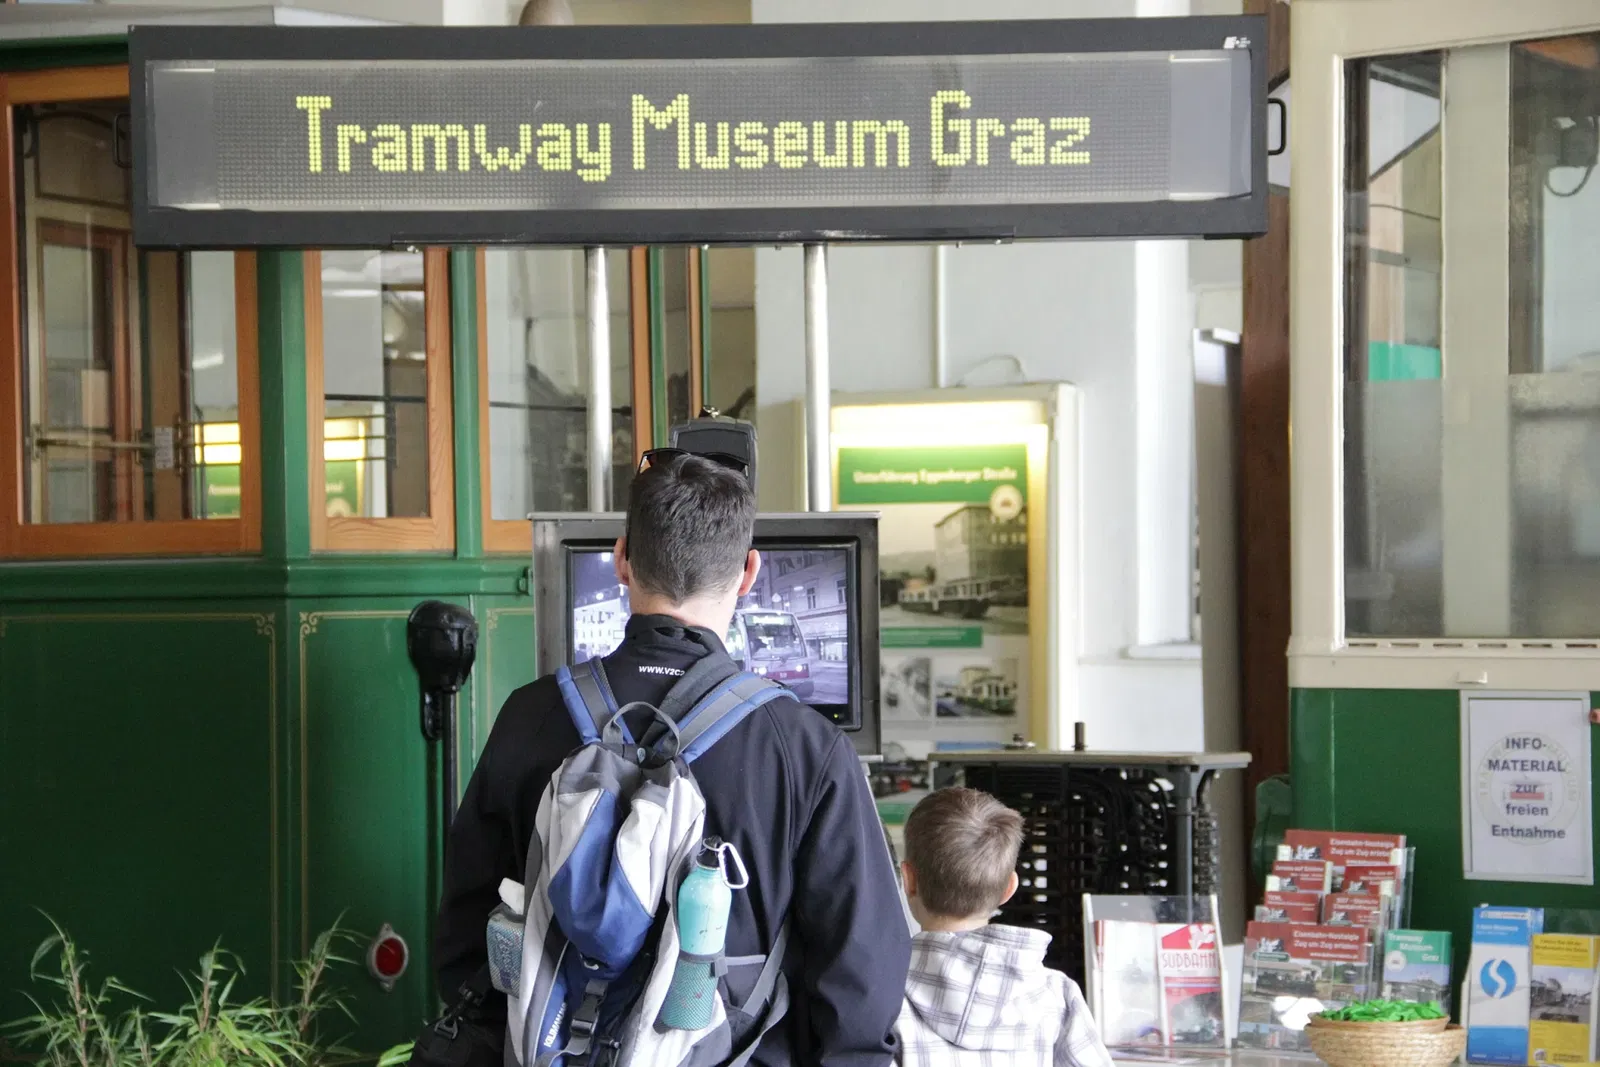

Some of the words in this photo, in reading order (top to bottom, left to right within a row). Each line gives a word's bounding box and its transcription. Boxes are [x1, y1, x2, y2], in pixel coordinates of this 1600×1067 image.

[296, 95, 612, 182] Tramway
[631, 93, 910, 170] Museum
[931, 89, 1091, 167] Graz
[1505, 737, 1547, 750] INFO-
[1488, 759, 1566, 773] MATERIAL
[1515, 783, 1538, 794] zur
[1505, 803, 1550, 816] freien
[1491, 824, 1566, 839] Entnahme
